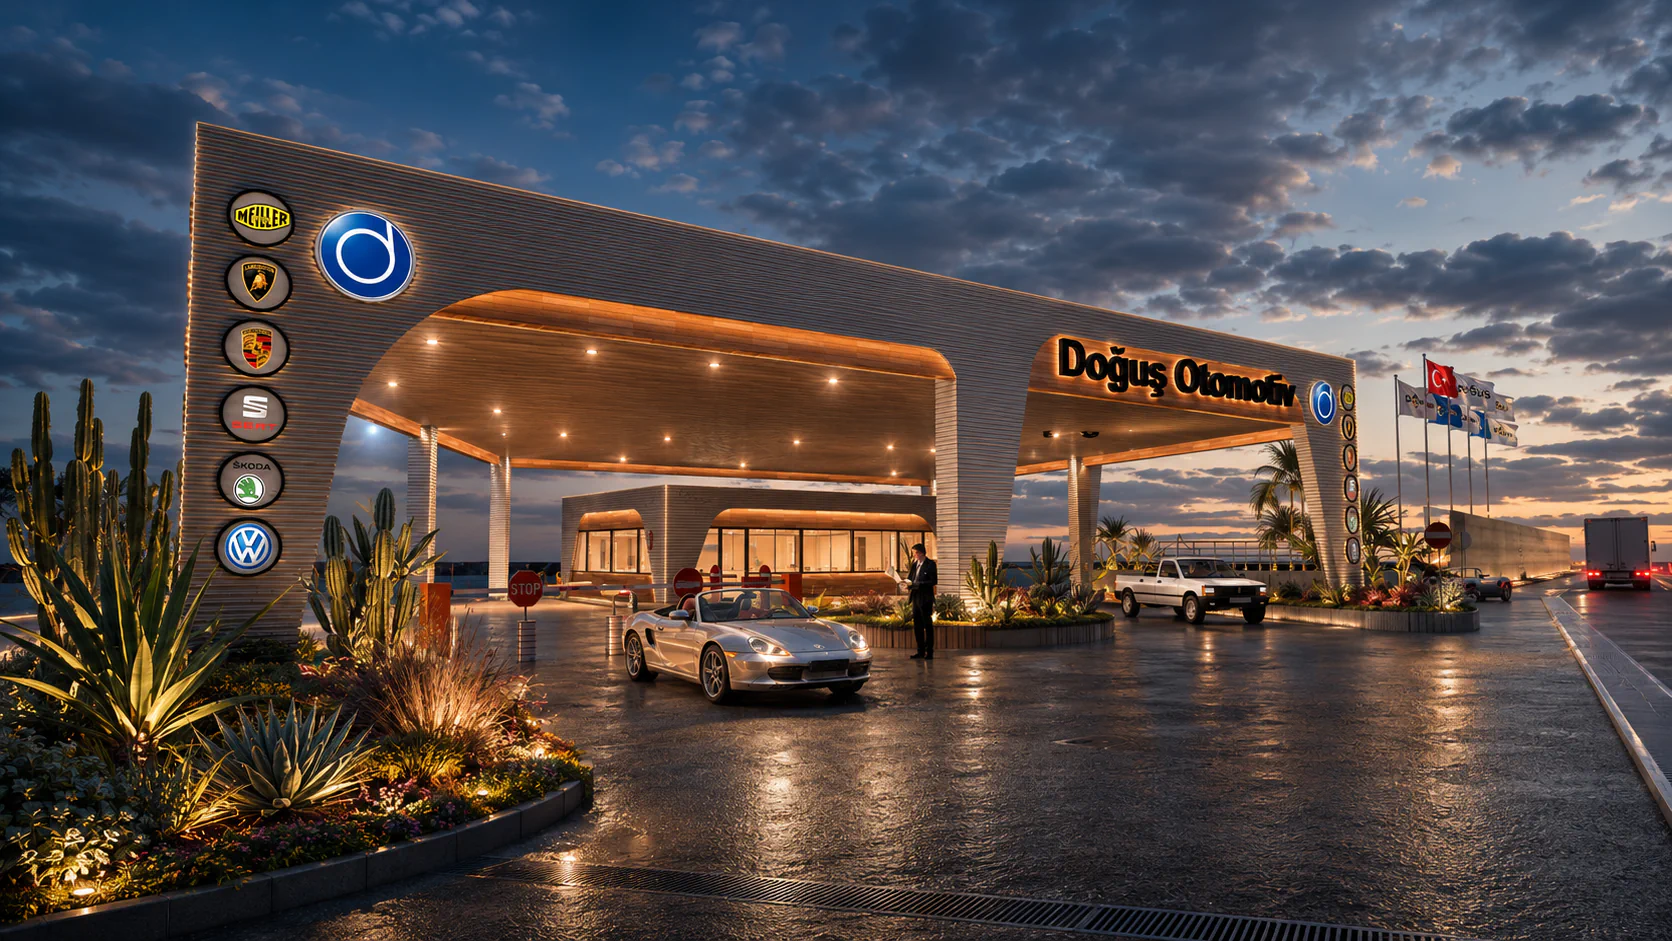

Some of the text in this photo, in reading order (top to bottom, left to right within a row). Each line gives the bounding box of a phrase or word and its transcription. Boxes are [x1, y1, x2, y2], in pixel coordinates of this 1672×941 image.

[238, 206, 288, 228] MEILLER
[1058, 338, 1296, 407] Doğuş Otomotiv
[233, 460, 271, 470] ŠKODA
[511, 583, 541, 595] STOP
